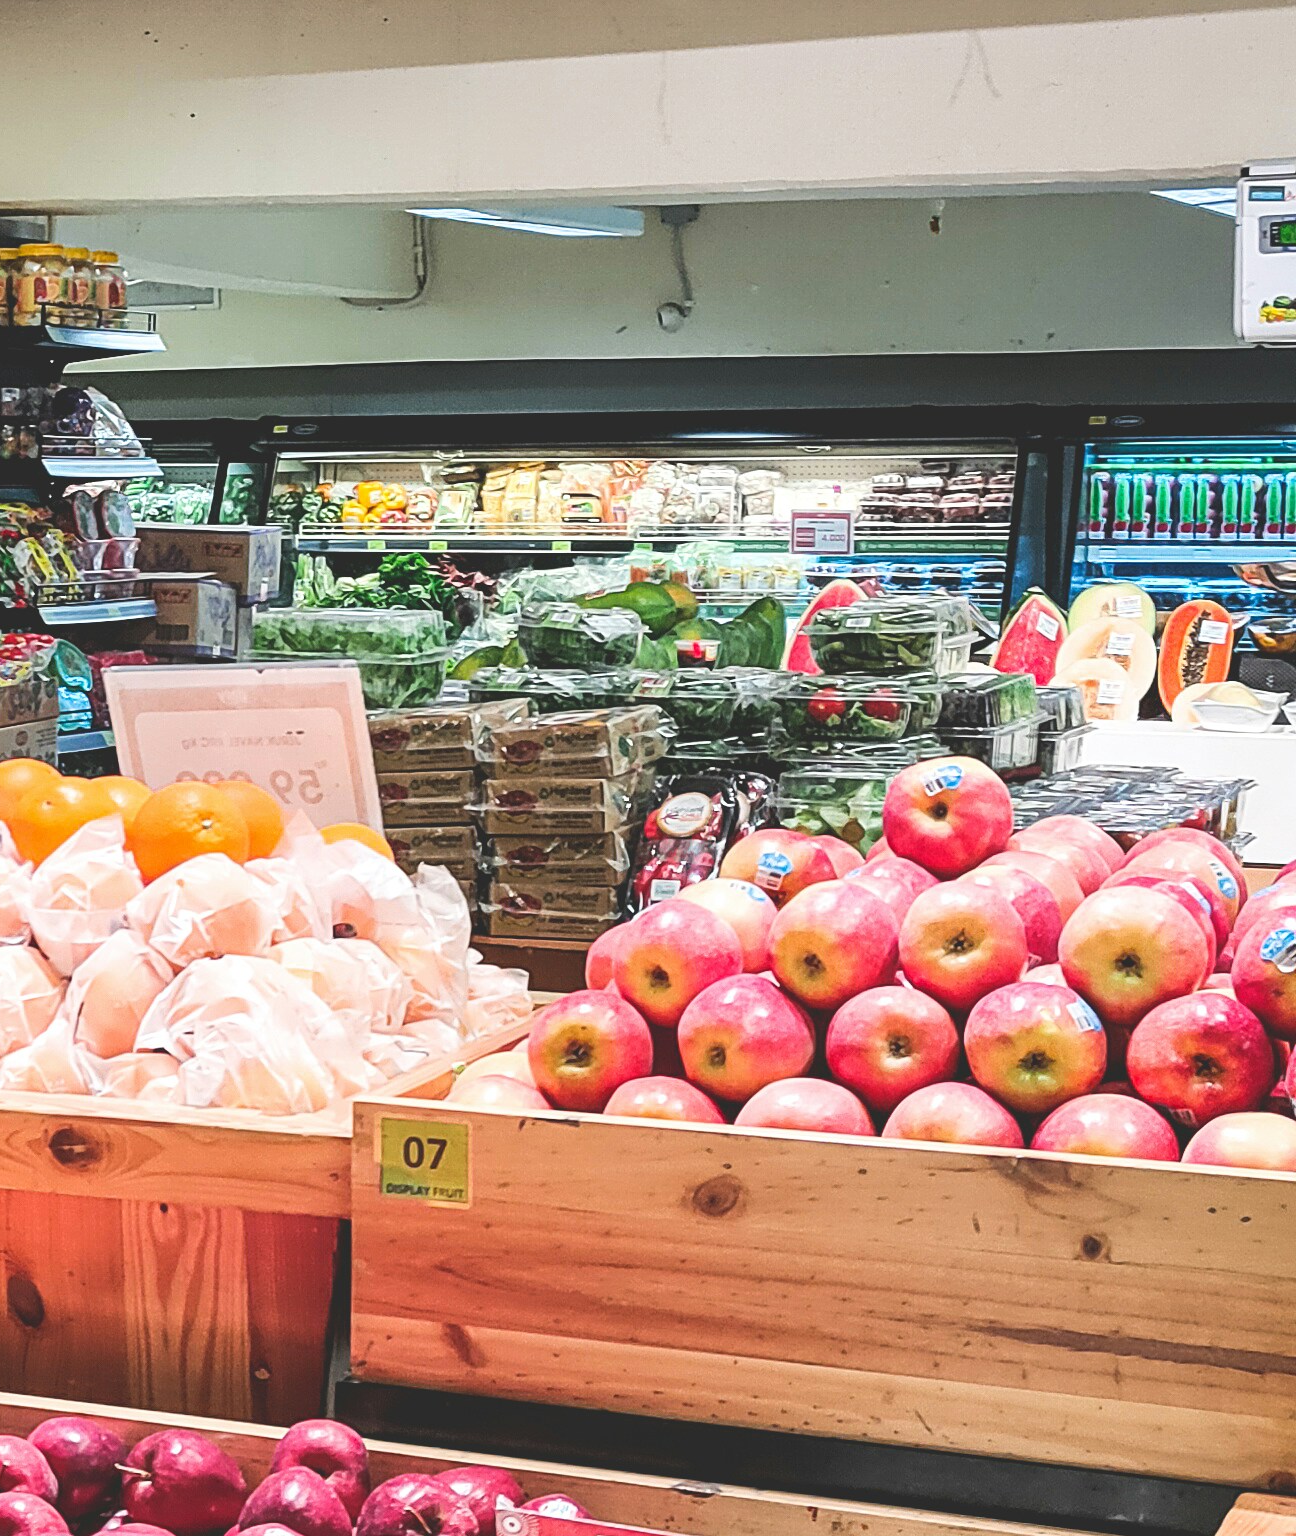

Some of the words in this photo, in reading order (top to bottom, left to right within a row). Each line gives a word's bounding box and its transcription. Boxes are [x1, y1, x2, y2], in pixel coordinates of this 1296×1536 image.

[403, 1136, 447, 1170] 07
[386, 1183, 430, 1196] DISPLAY
[433, 1187, 464, 1198] FRUIT
